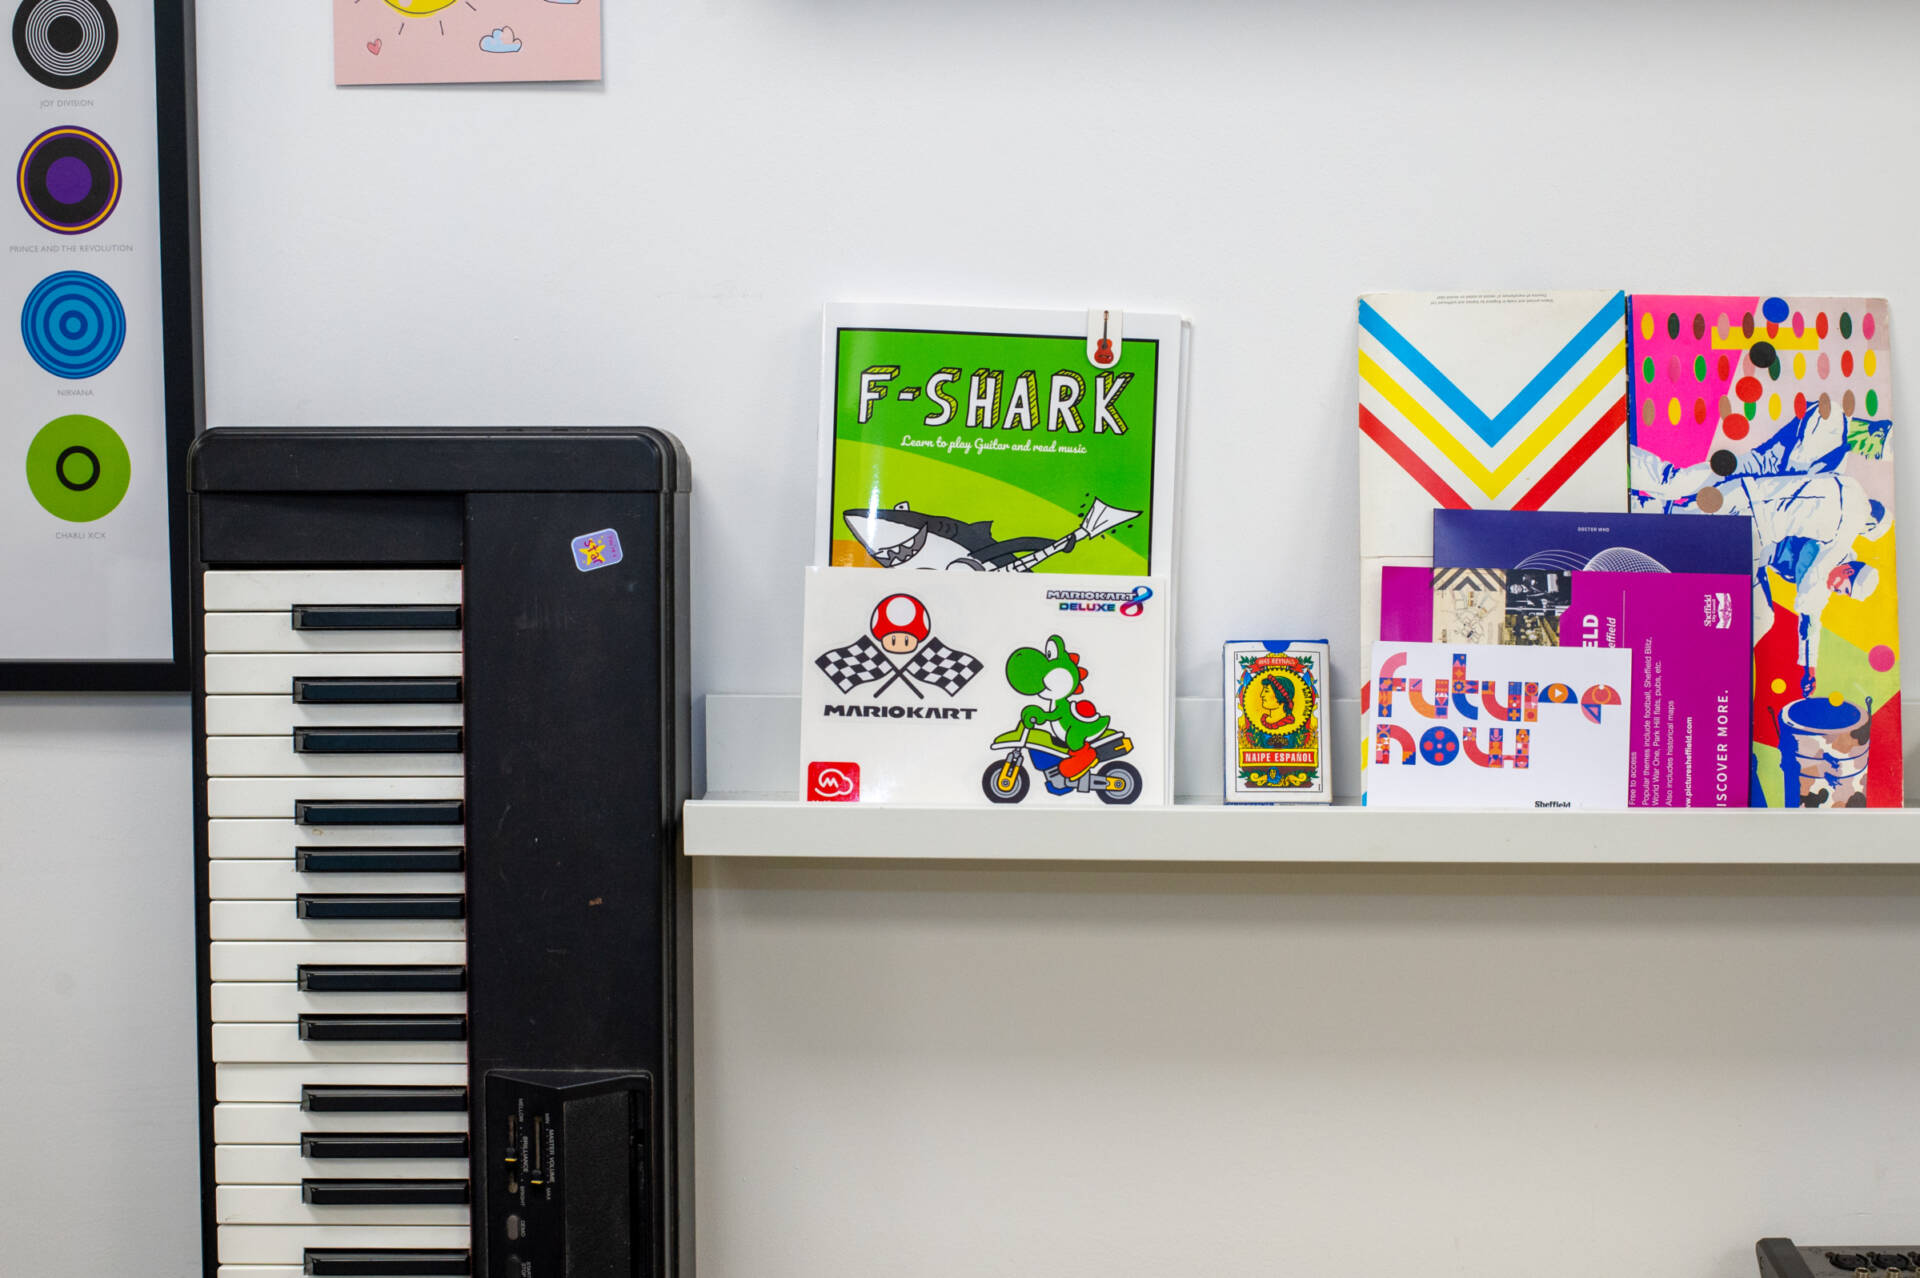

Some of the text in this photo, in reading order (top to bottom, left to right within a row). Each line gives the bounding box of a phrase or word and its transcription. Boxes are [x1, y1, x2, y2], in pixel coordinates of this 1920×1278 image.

[40, 100, 54, 109] JOY
[9, 245, 38, 253] PRINCE
[41, 245, 60, 253] AND
[79, 244, 133, 252] REVOLUTION
[57, 389, 93, 397] NIRVANA
[857, 365, 1135, 435] F-SHARK
[900, 434, 1087, 455] Learn to play Guitar and read music
[56, 532, 85, 540] CHARLI
[1059, 602, 1116, 612] DELUXE
[1606, 616, 1616, 648] effield
[1644, 656, 1652, 688] Sheffield
[1377, 651, 1622, 725] future
[1667, 700, 1676, 721] maps
[1643, 720, 1651, 747] include
[1666, 723, 1674, 756] historical
[1245, 753, 1271, 762] NAIPE
[1716, 689, 1728, 807] ISCOVER MORE.
[1642, 777, 1651, 806] Popular
[1652, 785, 1660, 806] World
[1665, 790, 1673, 806] Also
